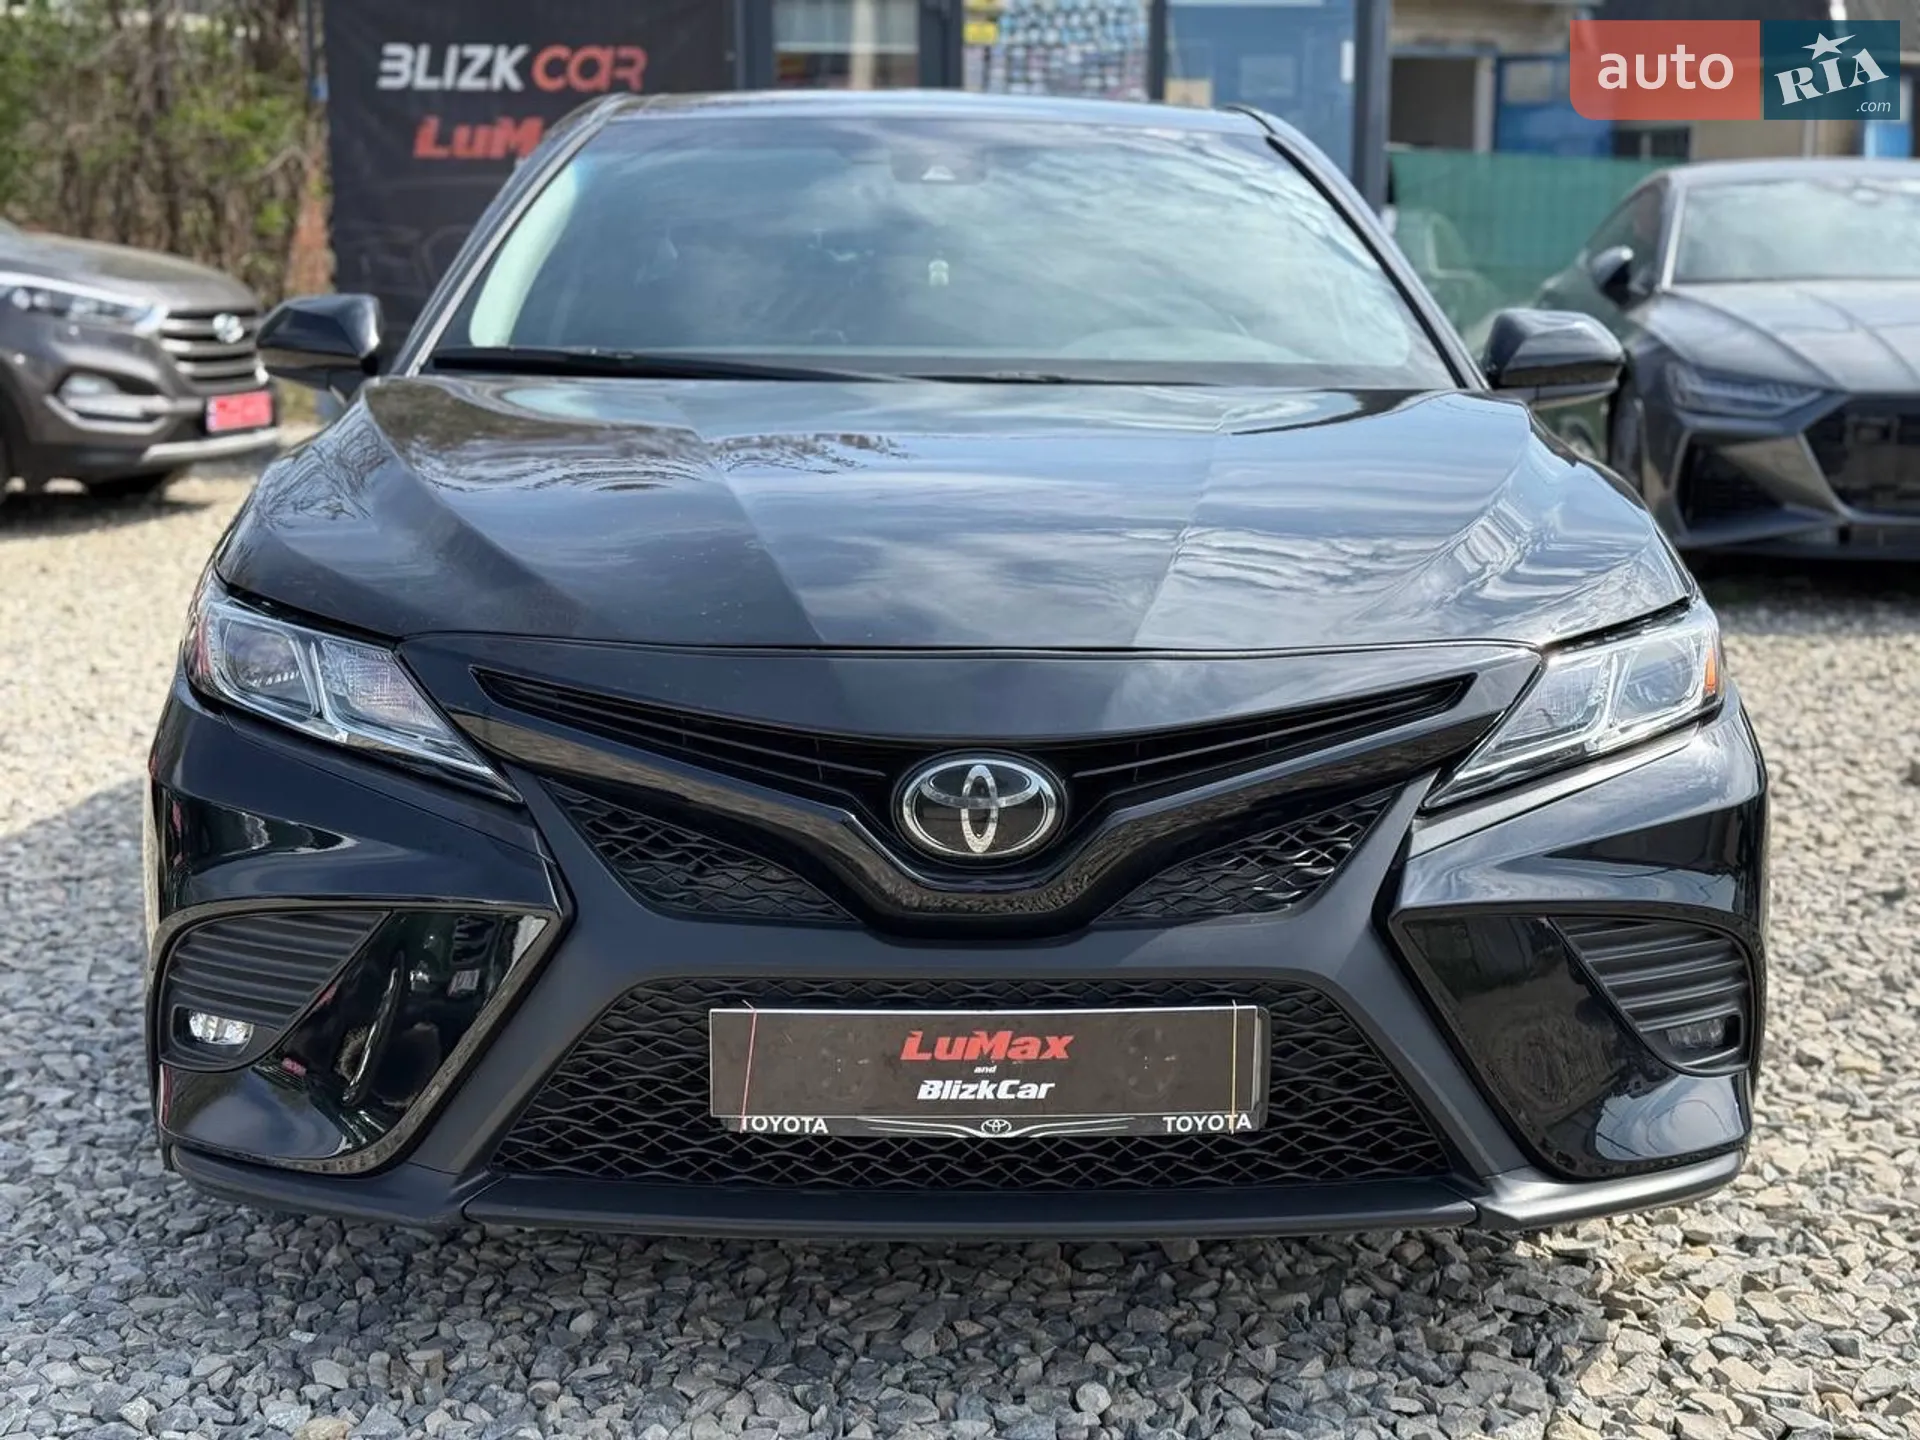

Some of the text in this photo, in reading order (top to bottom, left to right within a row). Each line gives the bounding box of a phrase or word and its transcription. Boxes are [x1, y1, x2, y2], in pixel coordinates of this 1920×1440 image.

[412, 115, 544, 159] LuM
[900, 1030, 1074, 1061] LuMax
[973, 1064, 998, 1074] and
[917, 1079, 1055, 1101] BlizkCar
[740, 1115, 829, 1134] TOYOTA
[1162, 1112, 1253, 1133] TOYOTA
